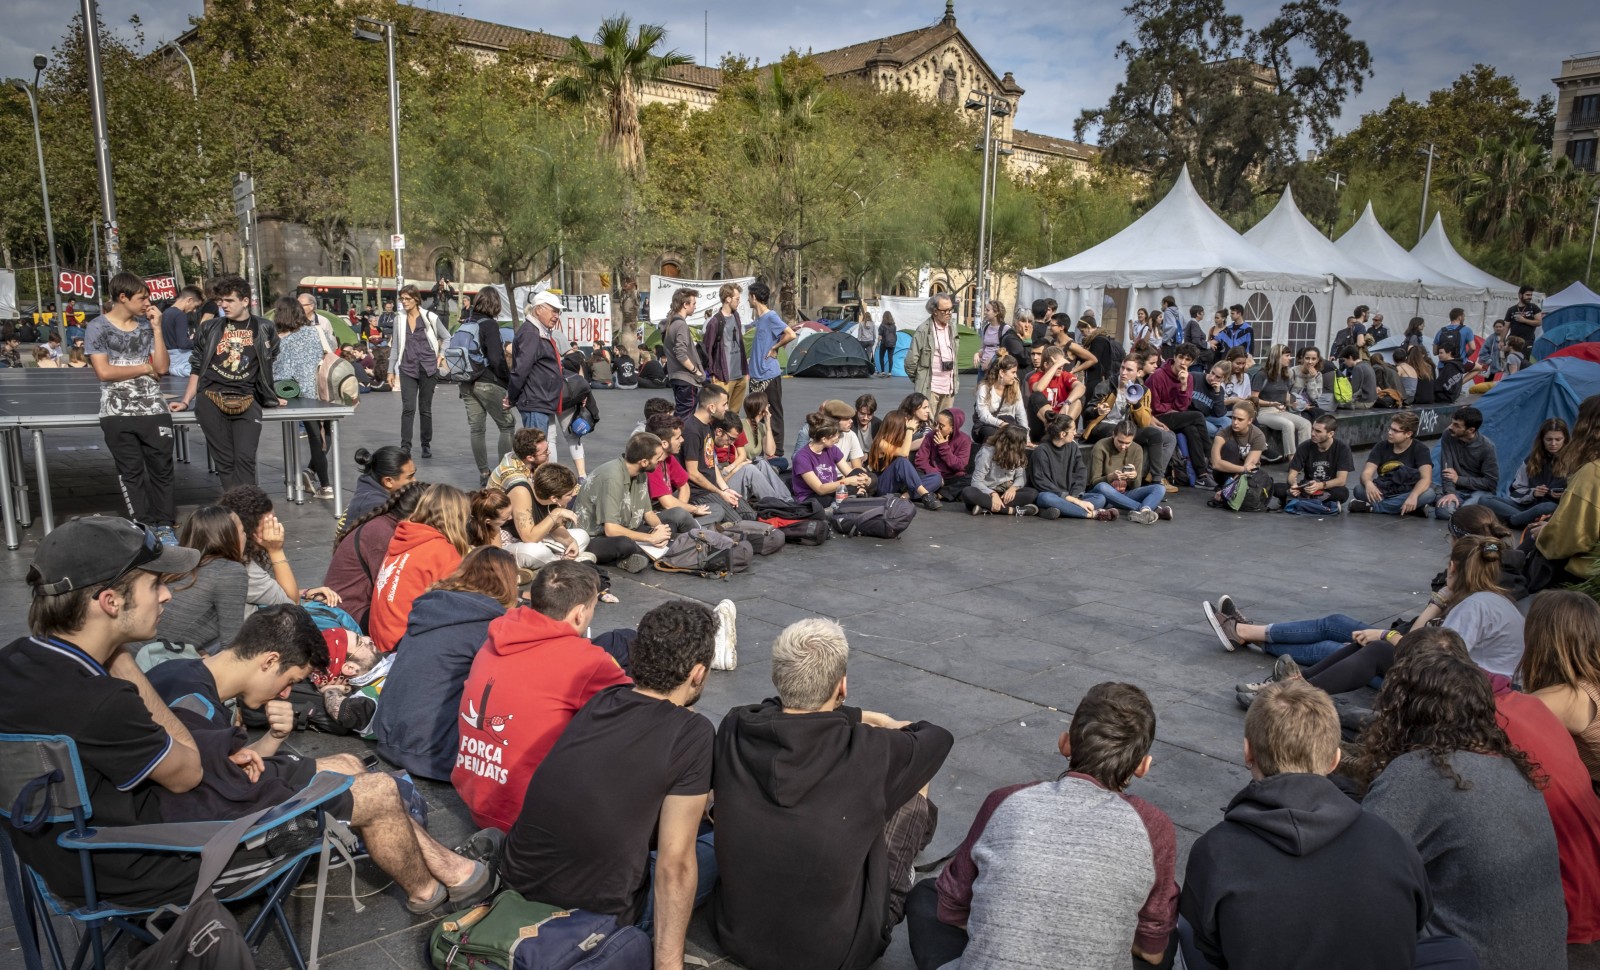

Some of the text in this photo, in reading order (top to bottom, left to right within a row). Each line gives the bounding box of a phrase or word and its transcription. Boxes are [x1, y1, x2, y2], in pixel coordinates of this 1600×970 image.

[60, 272, 95, 299] SOS
[576, 295, 607, 314] POBLE
[567, 317, 579, 342] EL
[461, 735, 502, 764] FORÇA
[456, 753, 509, 784] PENJATS
